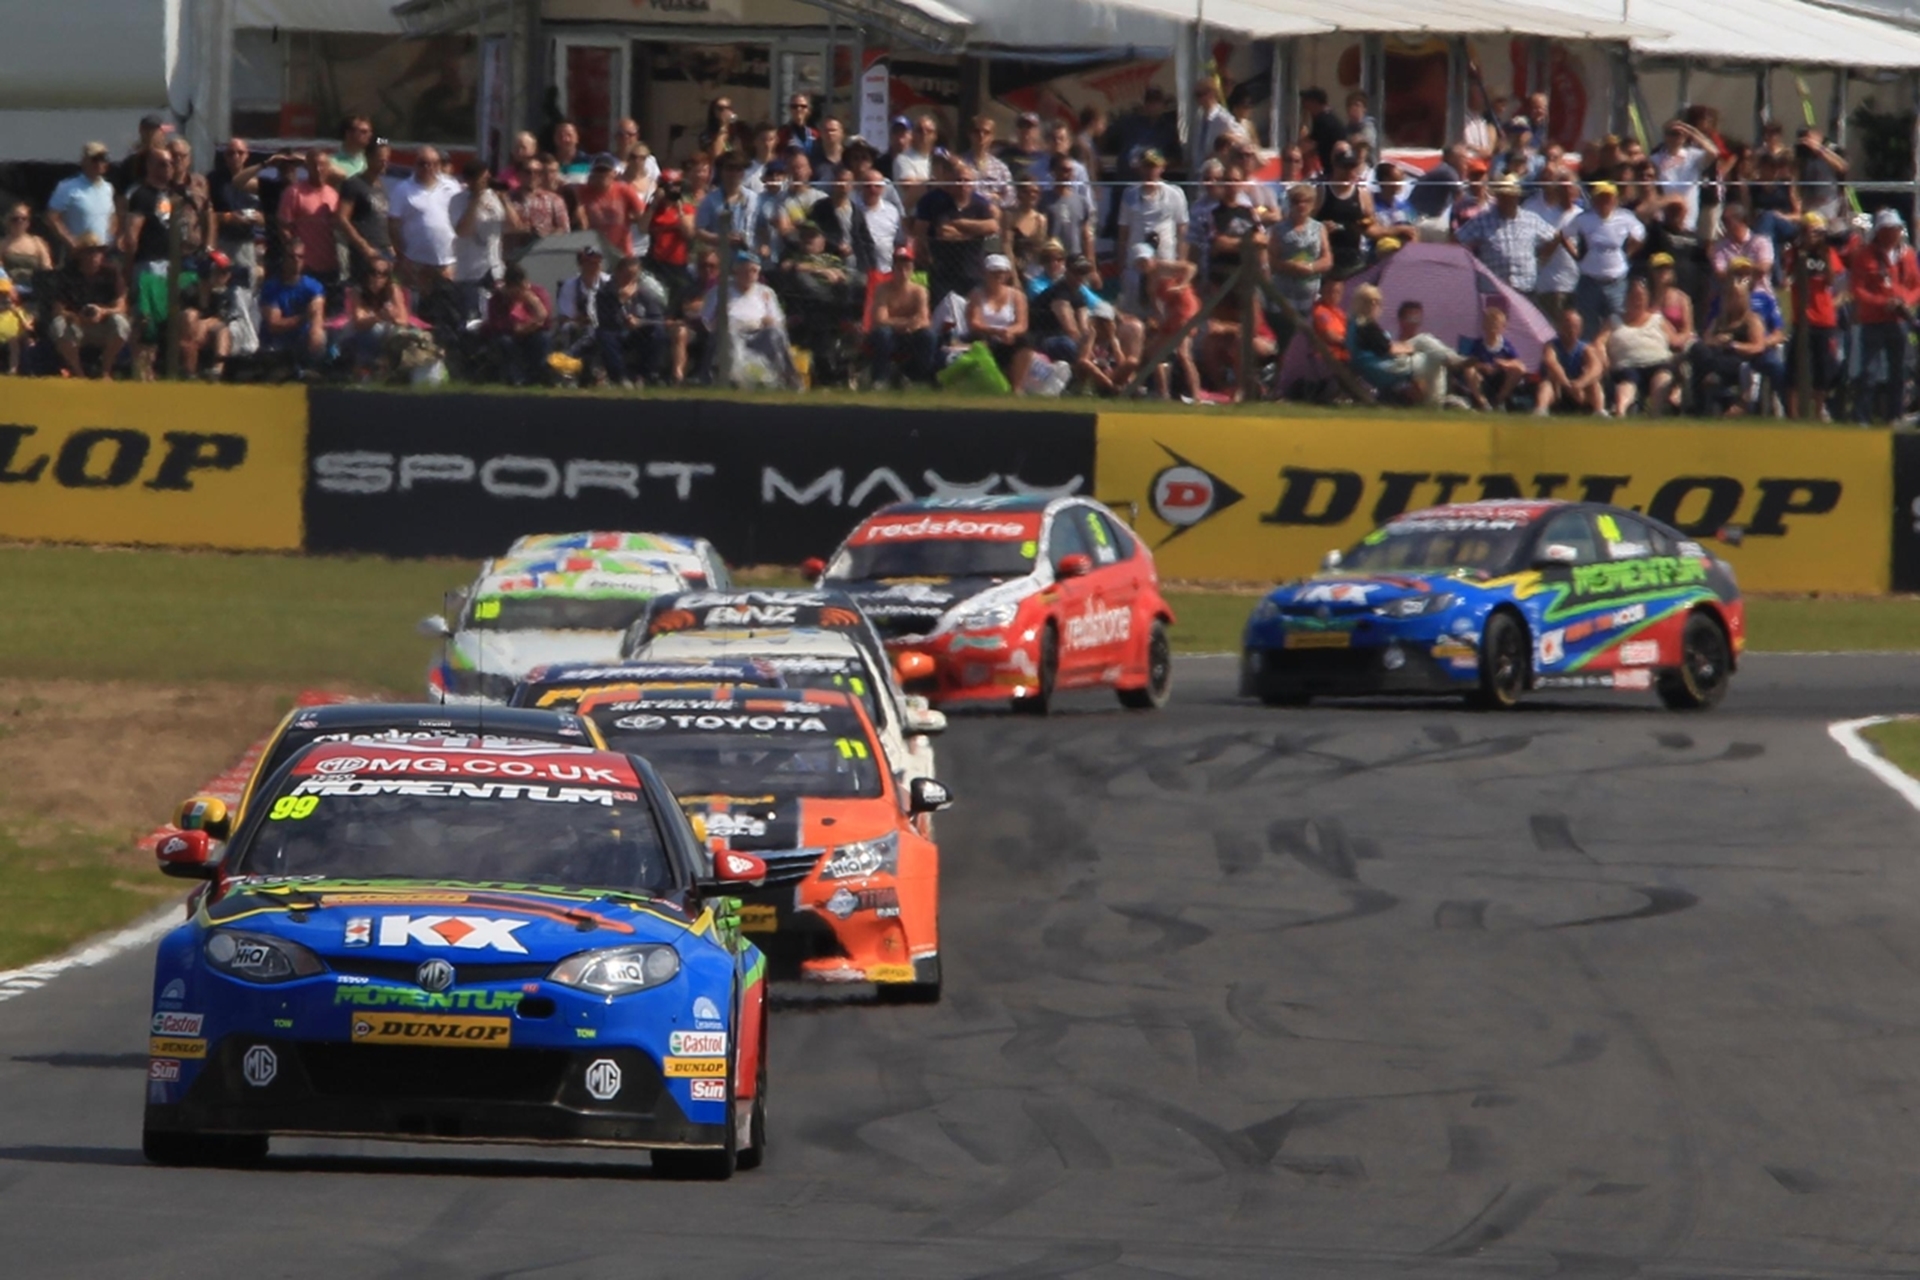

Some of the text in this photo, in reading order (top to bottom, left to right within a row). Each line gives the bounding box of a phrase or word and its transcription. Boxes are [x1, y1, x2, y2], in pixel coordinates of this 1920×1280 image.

[314, 450, 715, 499] SPORT
[866, 516, 1025, 540] redstone
[671, 714, 827, 731] TOYOTA
[834, 738, 868, 759] 11
[368, 758, 621, 784] MG.CO.UK
[290, 779, 614, 806] MOMENTUM
[269, 795, 320, 820] 99
[379, 915, 531, 954] KX
[334, 985, 525, 1010] MOMENTUM
[163, 1015, 200, 1033] Castrol
[379, 1021, 508, 1040] DUNLOP
[575, 1028, 596, 1038] TOW
[683, 1034, 723, 1053] Castrol
[150, 1061, 179, 1078] Sun
[674, 1063, 724, 1072] DUNLOP
[588, 1061, 619, 1097] MG
[693, 1082, 725, 1098] Sun
